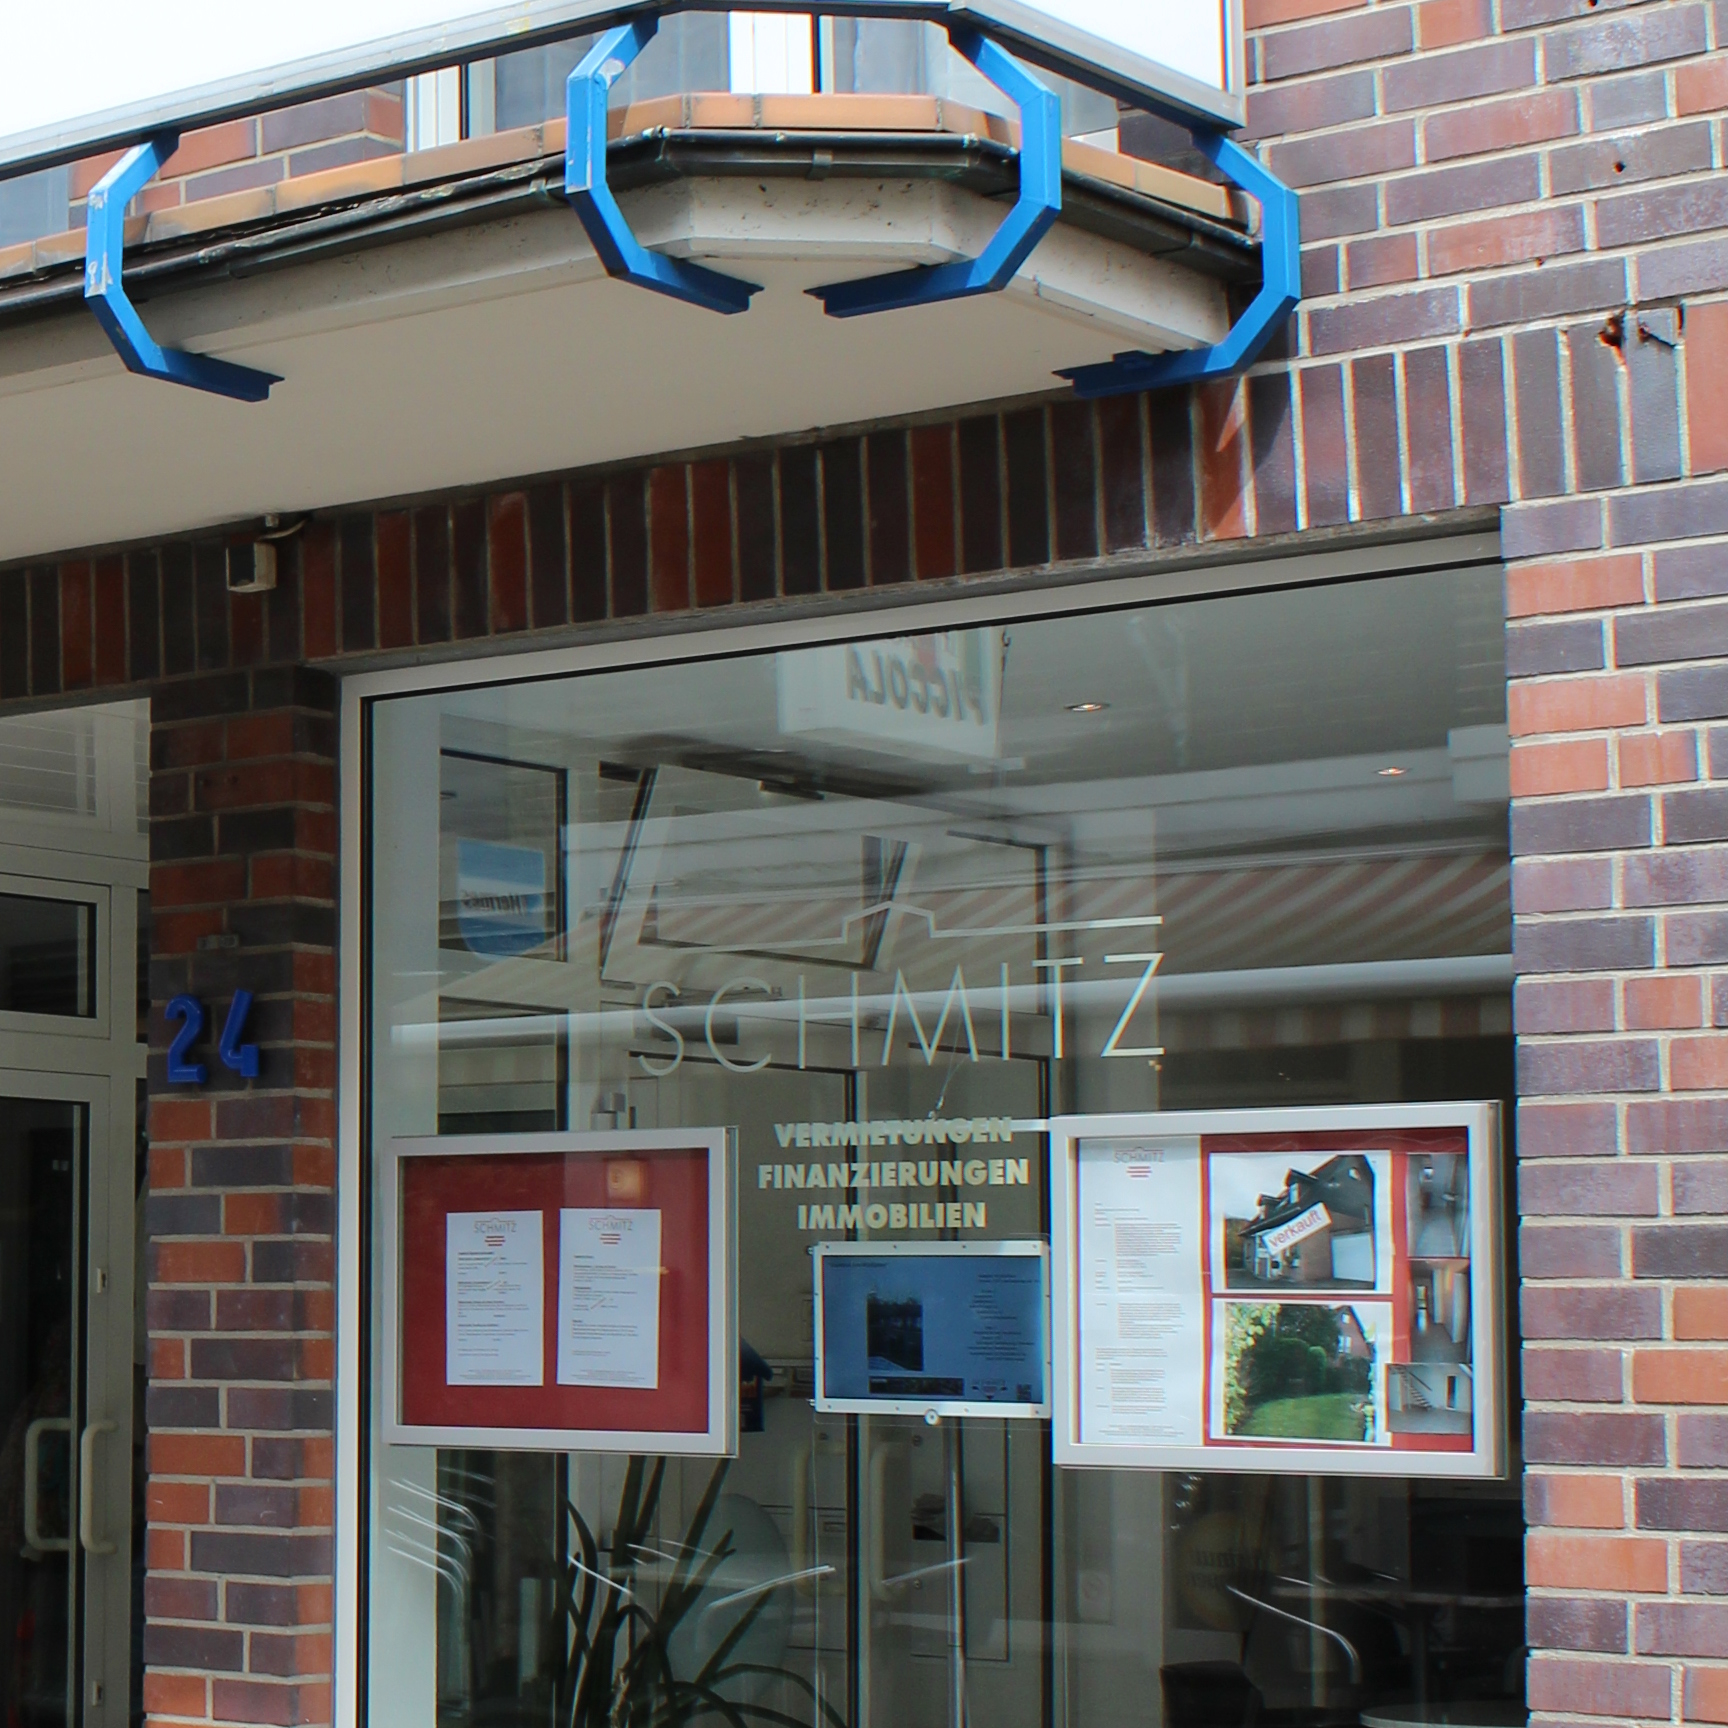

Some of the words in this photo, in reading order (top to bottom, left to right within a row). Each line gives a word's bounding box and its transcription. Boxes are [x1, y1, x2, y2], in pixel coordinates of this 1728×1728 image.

[639, 951, 1166, 1076] SCHMITZ
[164, 989, 260, 1084] 24
[773, 1116, 1013, 1148] VERMIETUNGEN
[1114, 1152, 1165, 1163] SCHMITZ
[758, 1158, 1030, 1189] FINANZIERUNGEN
[473, 1222, 518, 1234] SCHMITZ
[588, 1220, 633, 1232] SCHMITZ
[797, 1201, 987, 1230] IMMOBILIEN
[1268, 1210, 1322, 1247] verkauft
